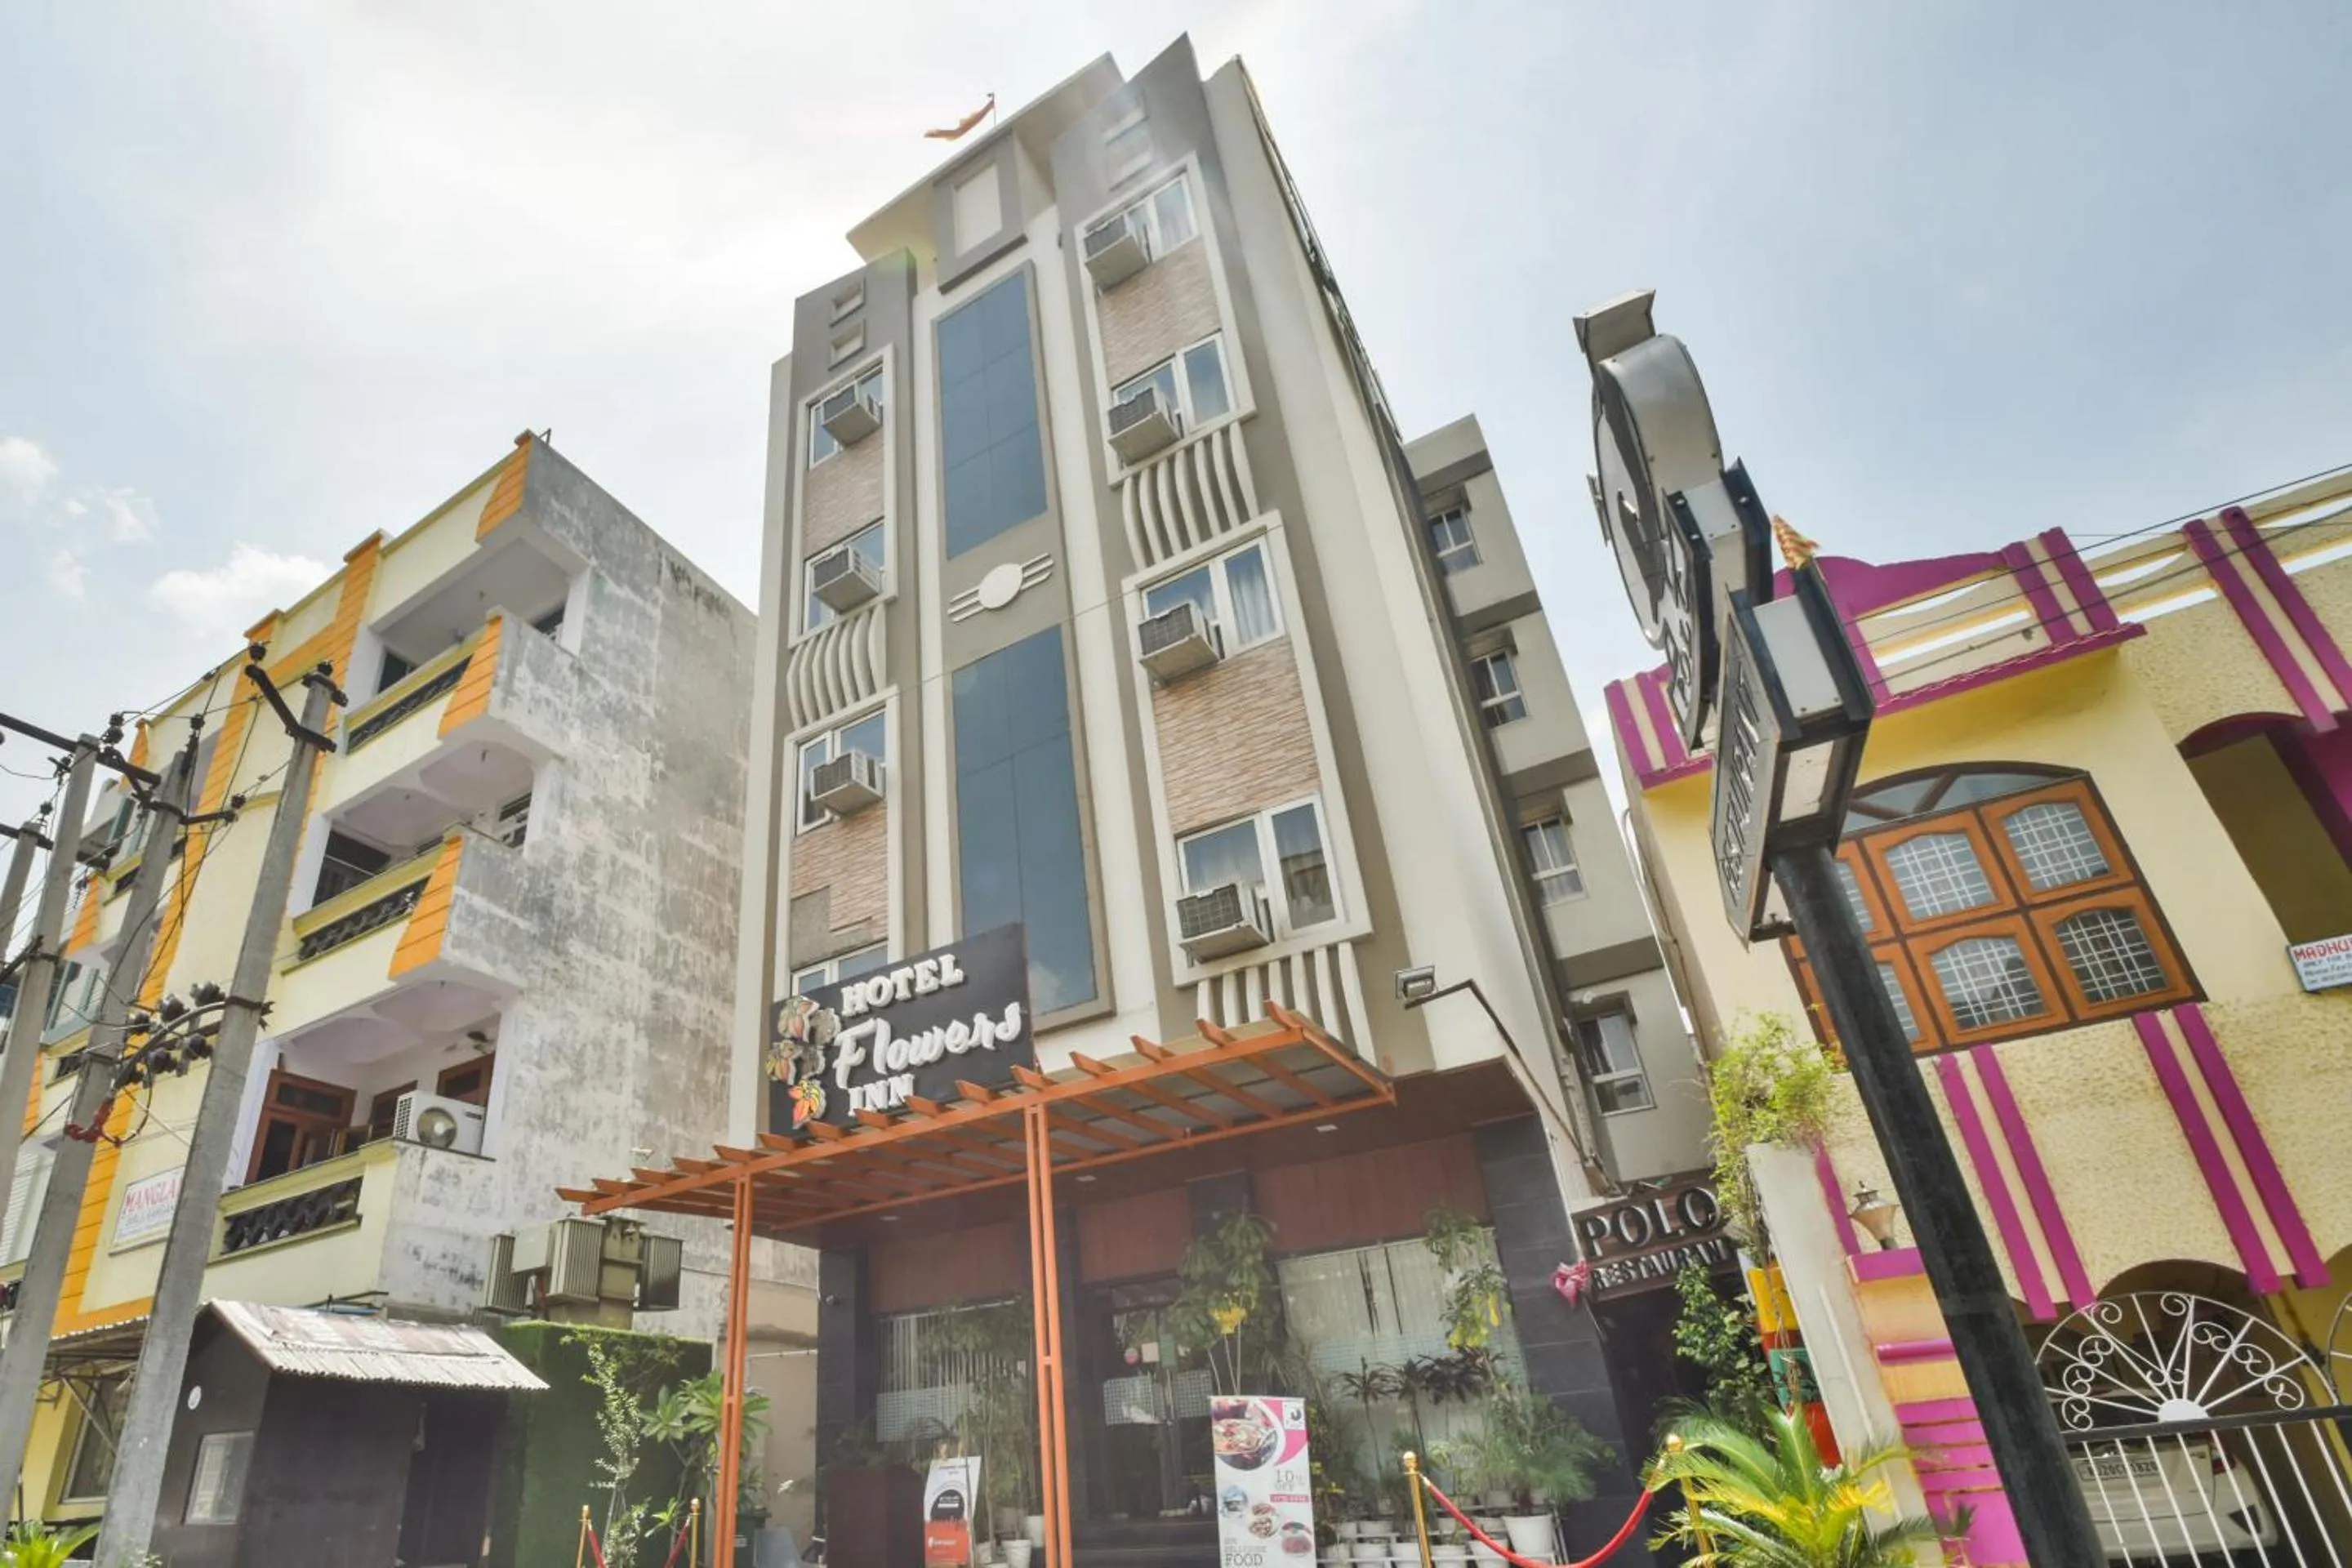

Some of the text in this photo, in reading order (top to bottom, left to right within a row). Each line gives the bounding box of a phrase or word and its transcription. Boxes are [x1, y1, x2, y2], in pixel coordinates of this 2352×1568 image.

[841, 954, 964, 1018] HOTEL
[833, 1001, 1022, 1089] Flowers
[849, 1074, 915, 1116] INN
[1584, 1186, 1721, 1258] POLO
[1225, 1553, 1263, 1567] FOOD
